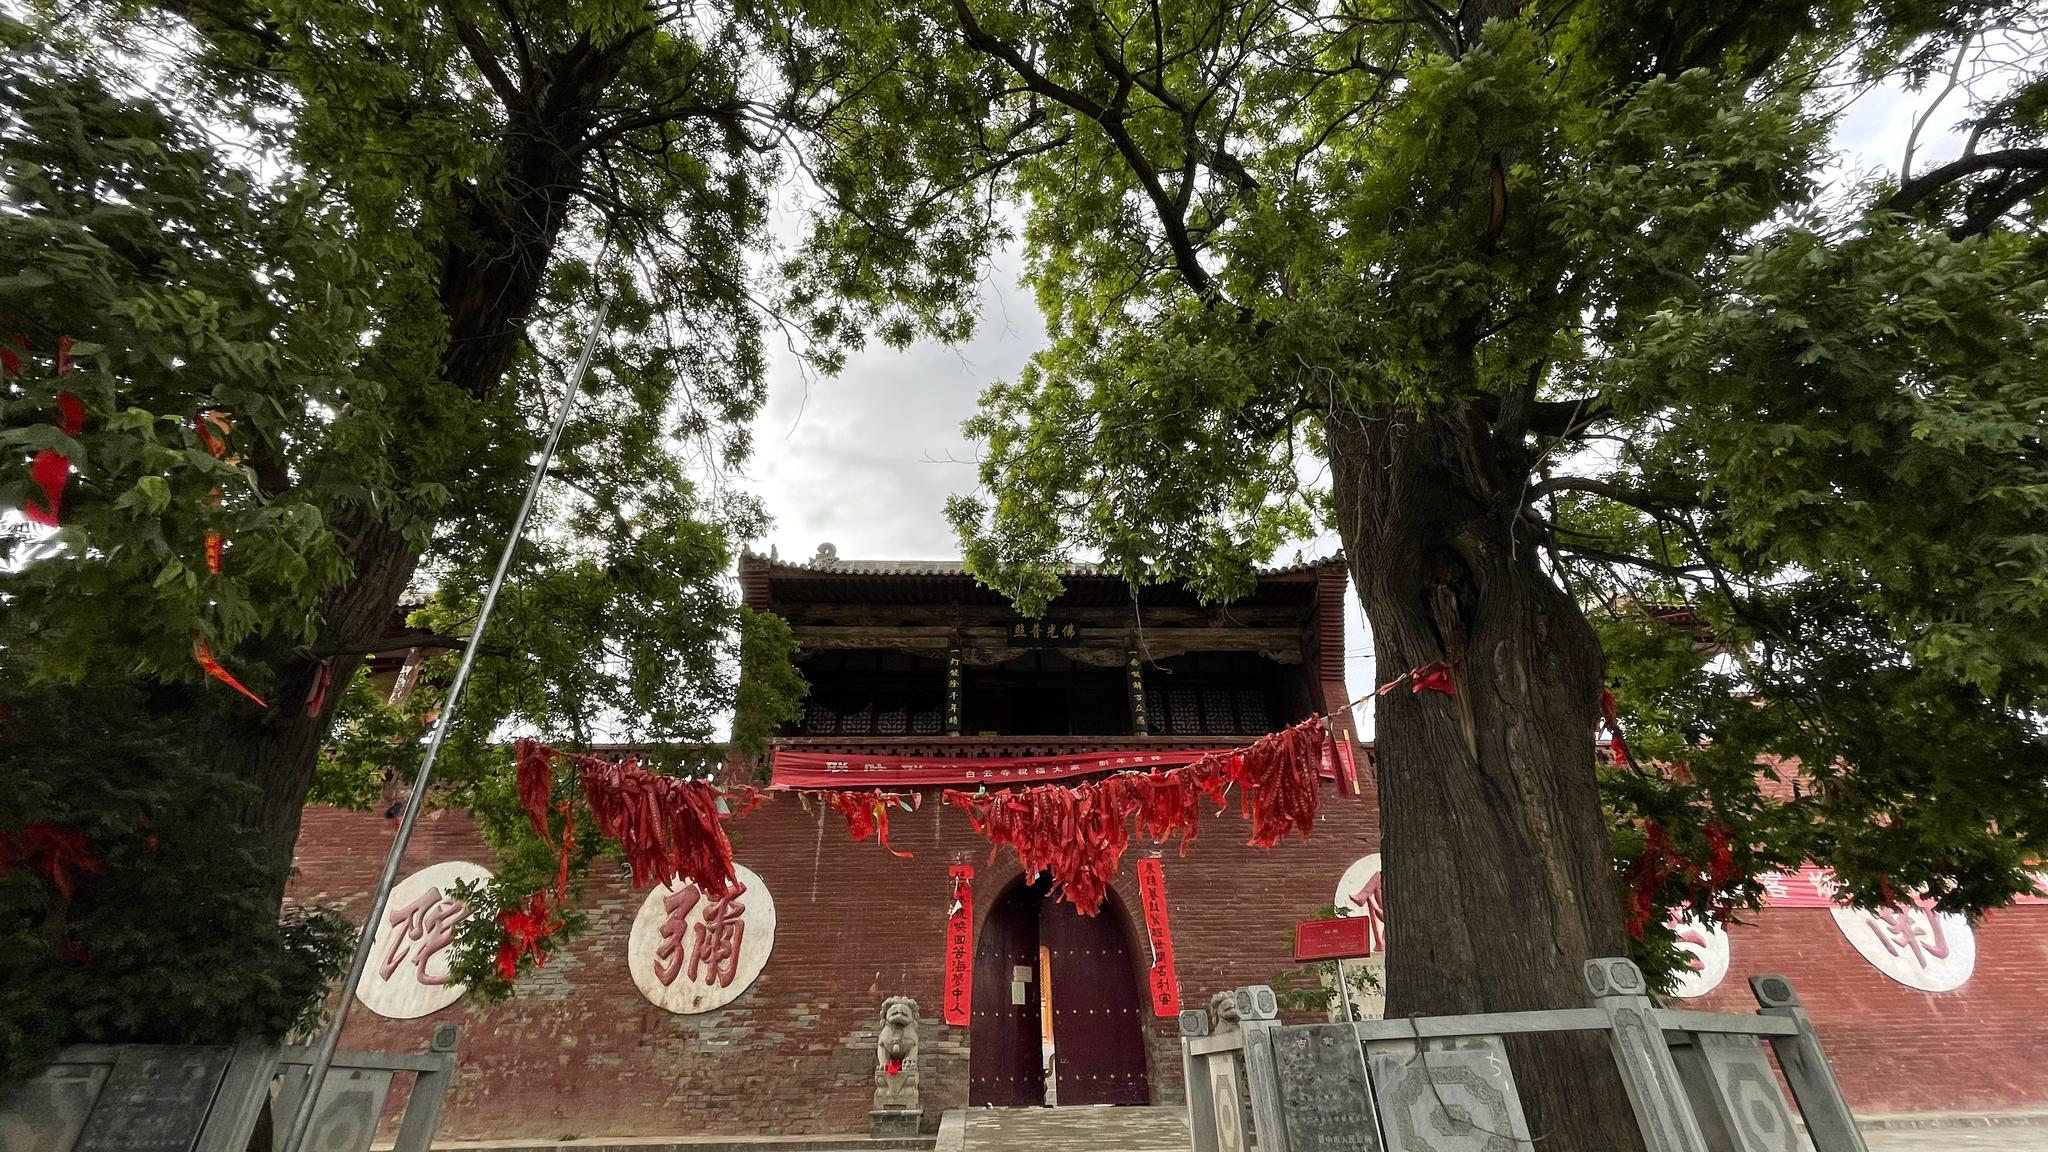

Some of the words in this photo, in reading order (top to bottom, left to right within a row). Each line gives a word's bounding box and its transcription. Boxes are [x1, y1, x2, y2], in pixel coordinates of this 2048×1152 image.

[965, 764, 1081, 779] 白云寺祝福大家
